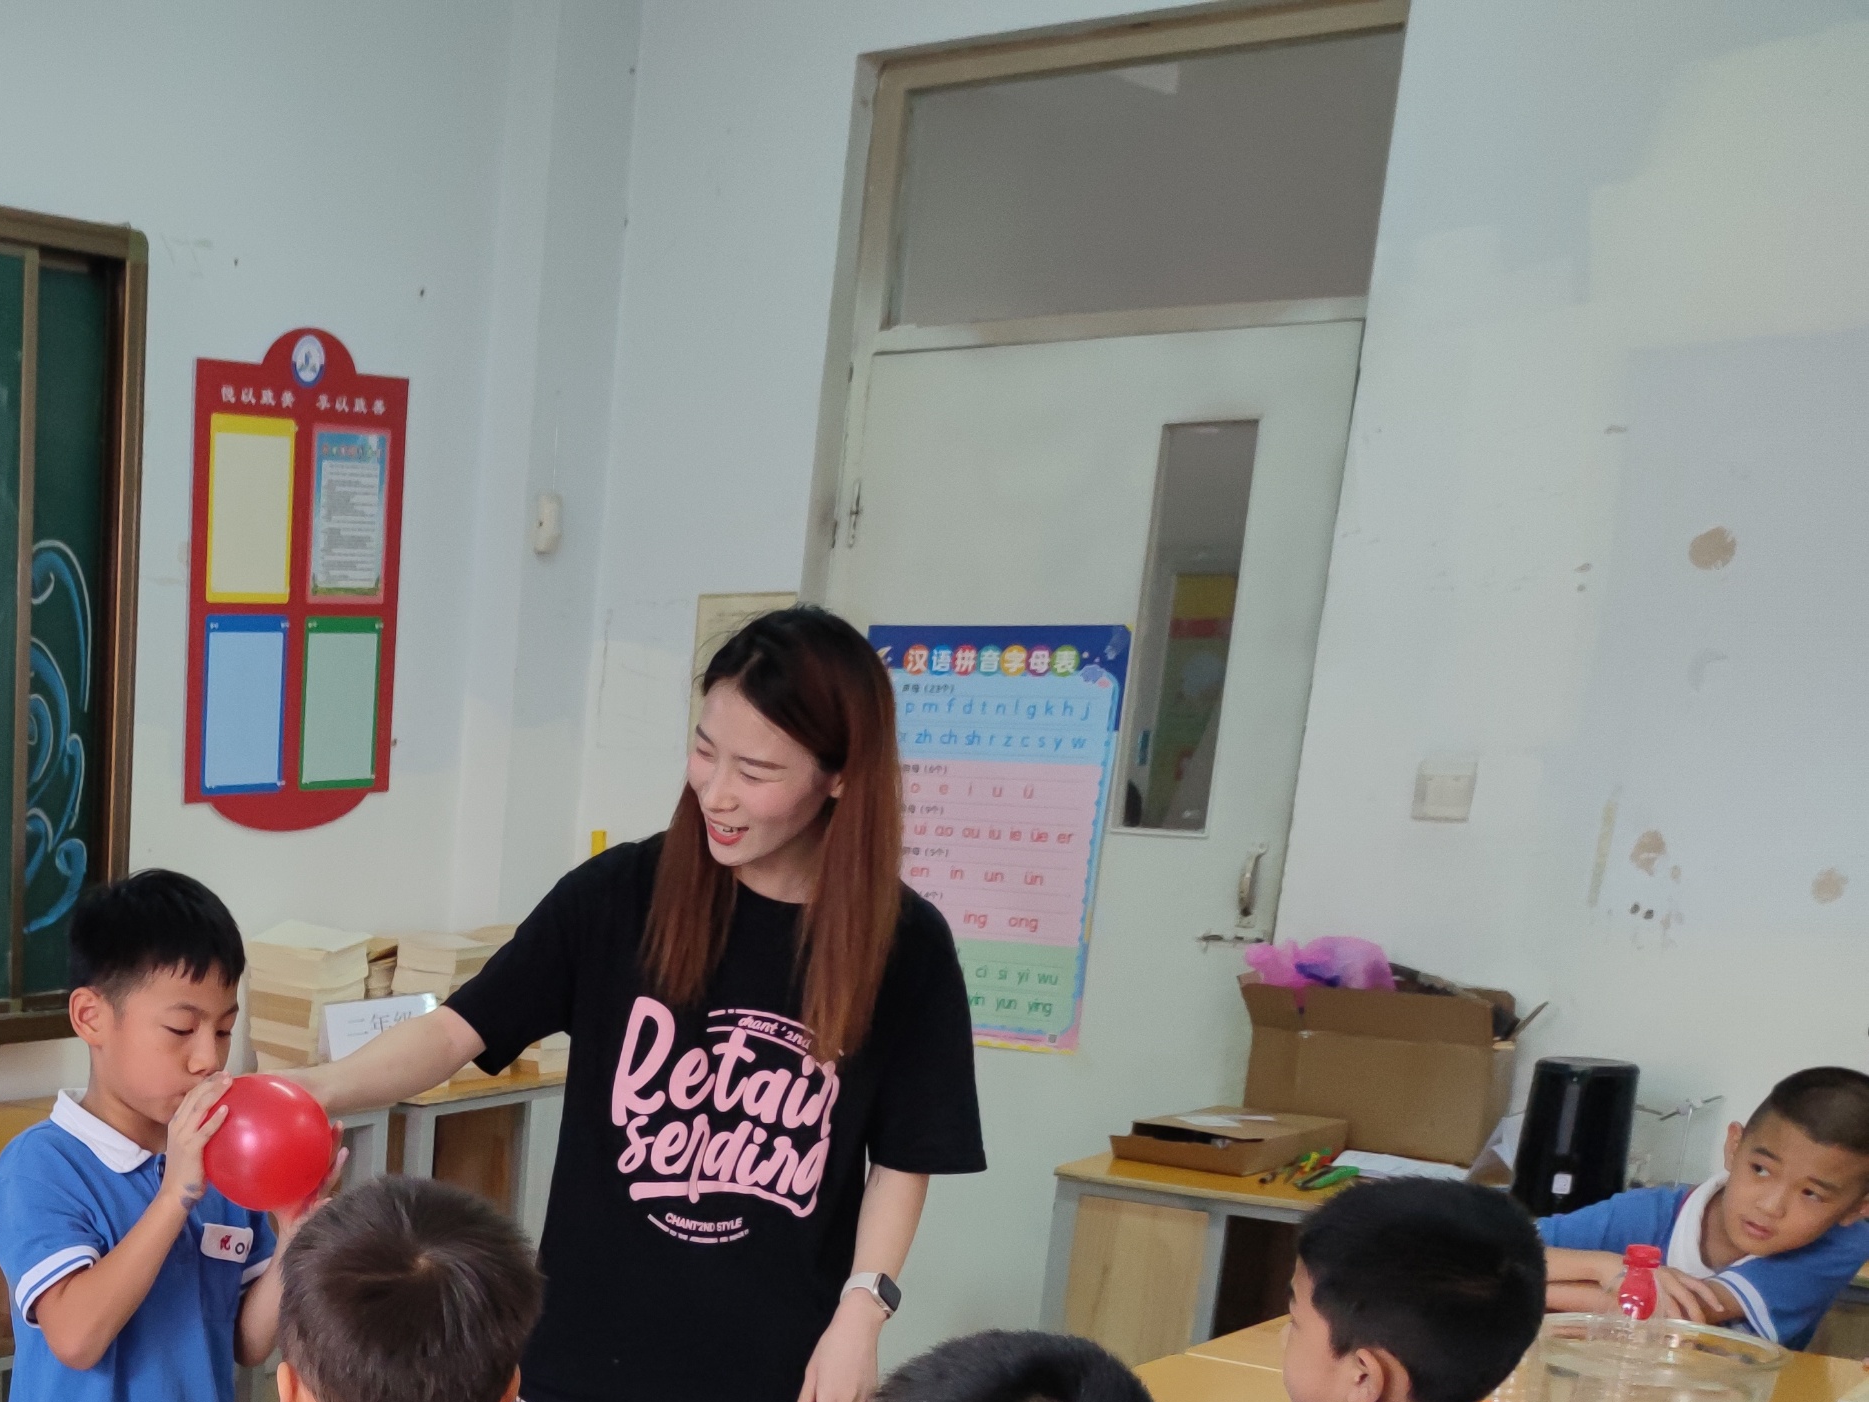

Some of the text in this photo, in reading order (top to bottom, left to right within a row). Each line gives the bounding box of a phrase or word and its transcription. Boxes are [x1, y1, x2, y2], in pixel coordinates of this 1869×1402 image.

[906, 650, 1077, 674] 汉语拼音字母表
[963, 910, 1039, 933] ing ong
[1037, 973, 1059, 986] wu
[716, 1216, 744, 1232] STYLE
